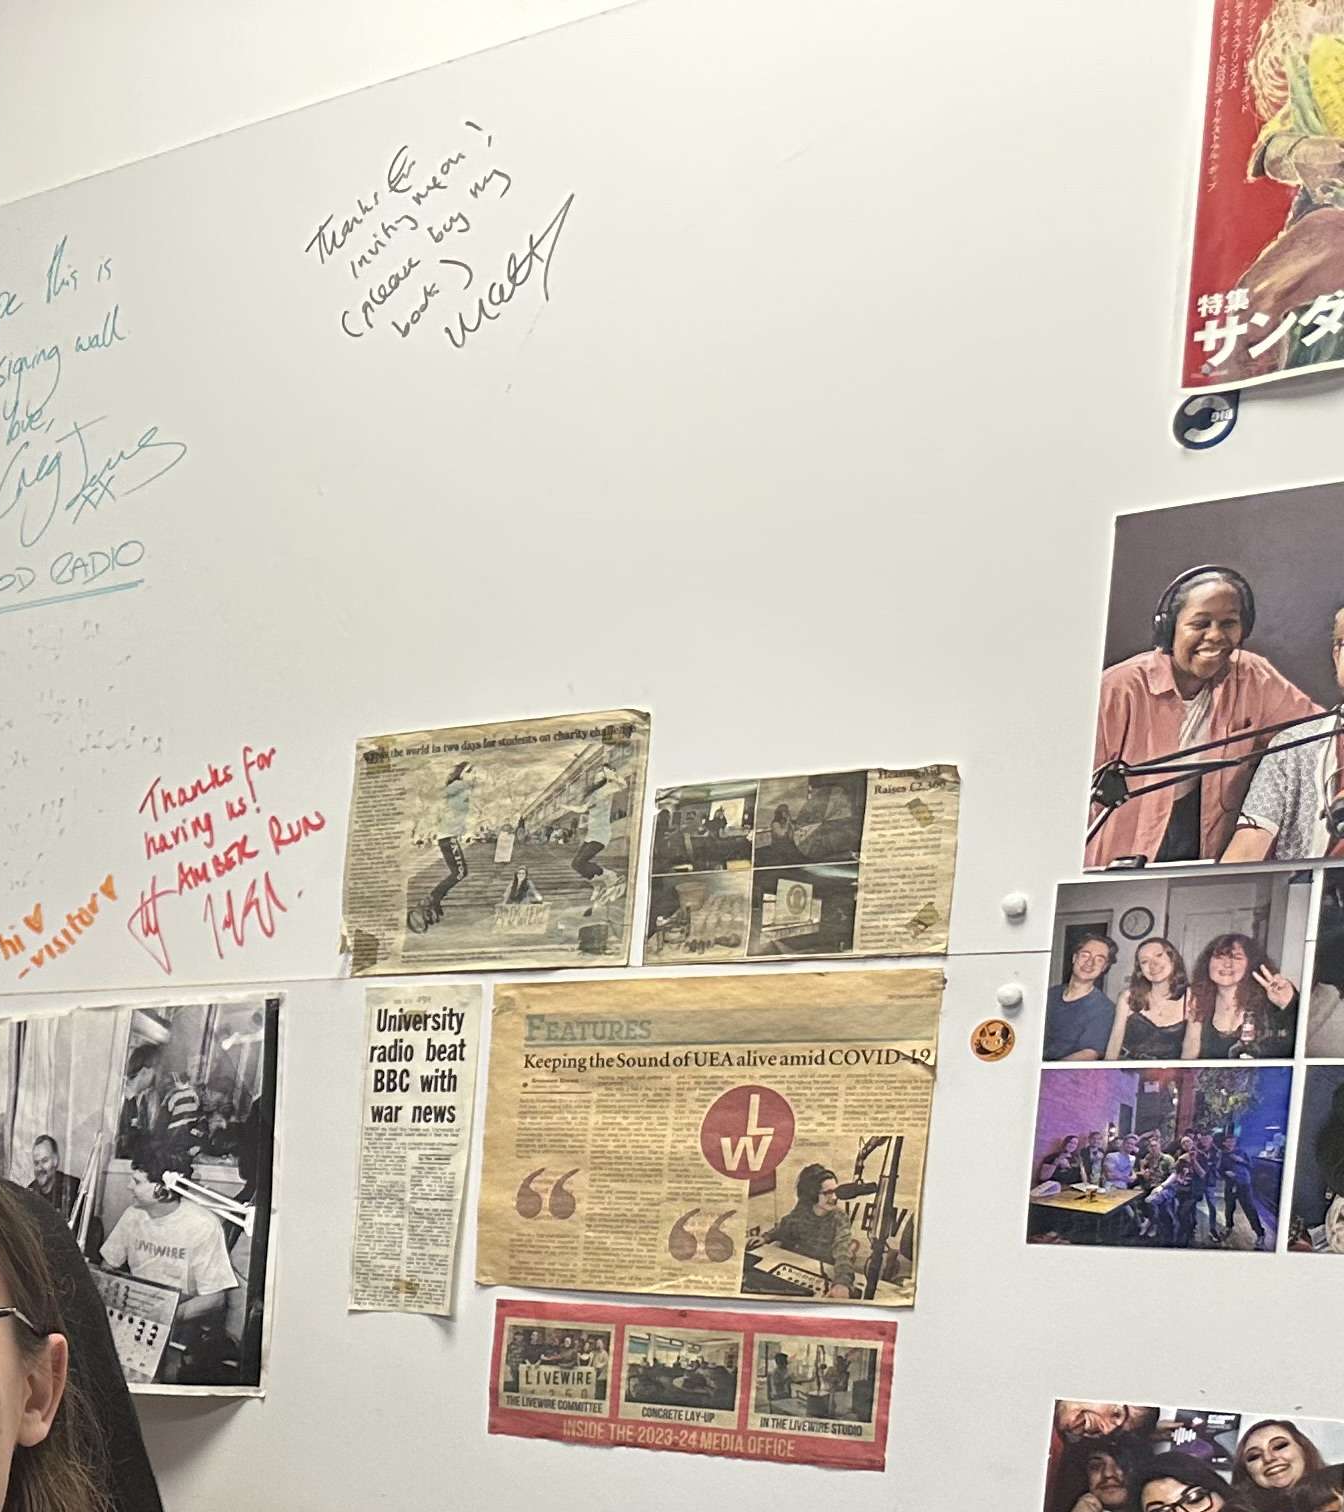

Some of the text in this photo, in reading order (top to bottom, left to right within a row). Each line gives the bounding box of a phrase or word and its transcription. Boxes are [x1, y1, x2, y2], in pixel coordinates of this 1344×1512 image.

[429, 212, 470, 243] buy
[470, 169, 511, 199] my
[305, 192, 379, 264] Thanks
[47, 234, 78, 303] this
[97, 258, 113, 282] is
[1197, 288, 1250, 317] 特集
[49, 540, 145, 586] RADIO
[406, 745, 430, 756] world
[443, 742, 459, 752] two
[461, 740, 481, 752] days
[483, 738, 496, 748] for
[498, 735, 537, 746] students
[539, 734, 551, 742] on
[554, 728, 587, 740] charity
[138, 746, 276, 823] Thanks for
[144, 812, 214, 861] having
[178, 811, 326, 896] AMBER RUN
[376, 1006, 465, 1036] University
[369, 1037, 467, 1063] radio beat
[524, 1046, 932, 1073] Keeping the Sound of UEA alive amid COVID-19
[373, 1068, 458, 1093] BBC with
[370, 1105, 456, 1123] war news
[747, 1094, 775, 1136] L
[722, 1135, 774, 1171] W
[134, 1240, 187, 1260] LIVEWIRE
[525, 1370, 593, 1387] LIVEWIRE
[506, 1395, 603, 1414] THE LIVEWIRE COMMITTEE
[641, 1407, 716, 1423] CONCRETE LAY-UP
[563, 1419, 796, 1457] INSIDE THE 2023-24 MEDIA OFFICE
[760, 1417, 863, 1437] IN THE LIVEWIRE STUDIO
